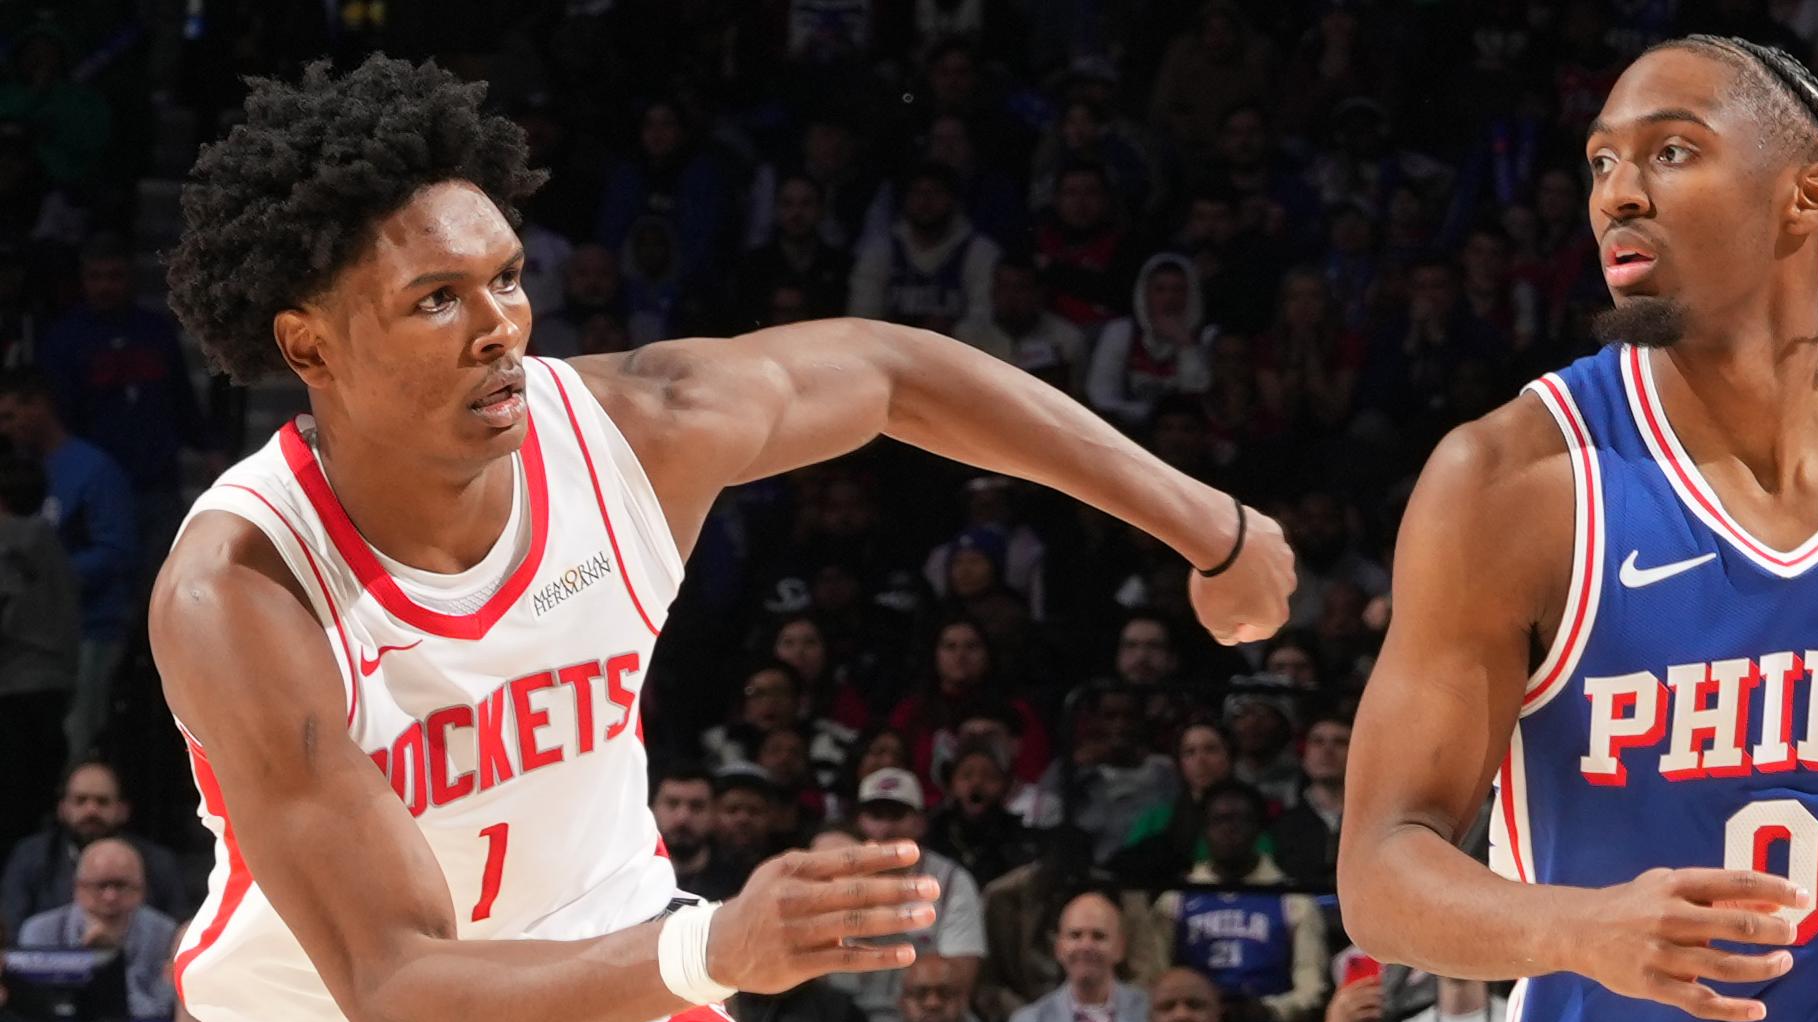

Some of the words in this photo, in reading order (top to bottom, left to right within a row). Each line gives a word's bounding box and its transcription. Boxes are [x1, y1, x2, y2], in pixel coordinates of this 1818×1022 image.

[532, 550, 610, 603] MEMORIAL
[533, 561, 612, 617] HERMANN
[369, 651, 642, 819] OCKETS
[471, 821, 510, 923] 1
